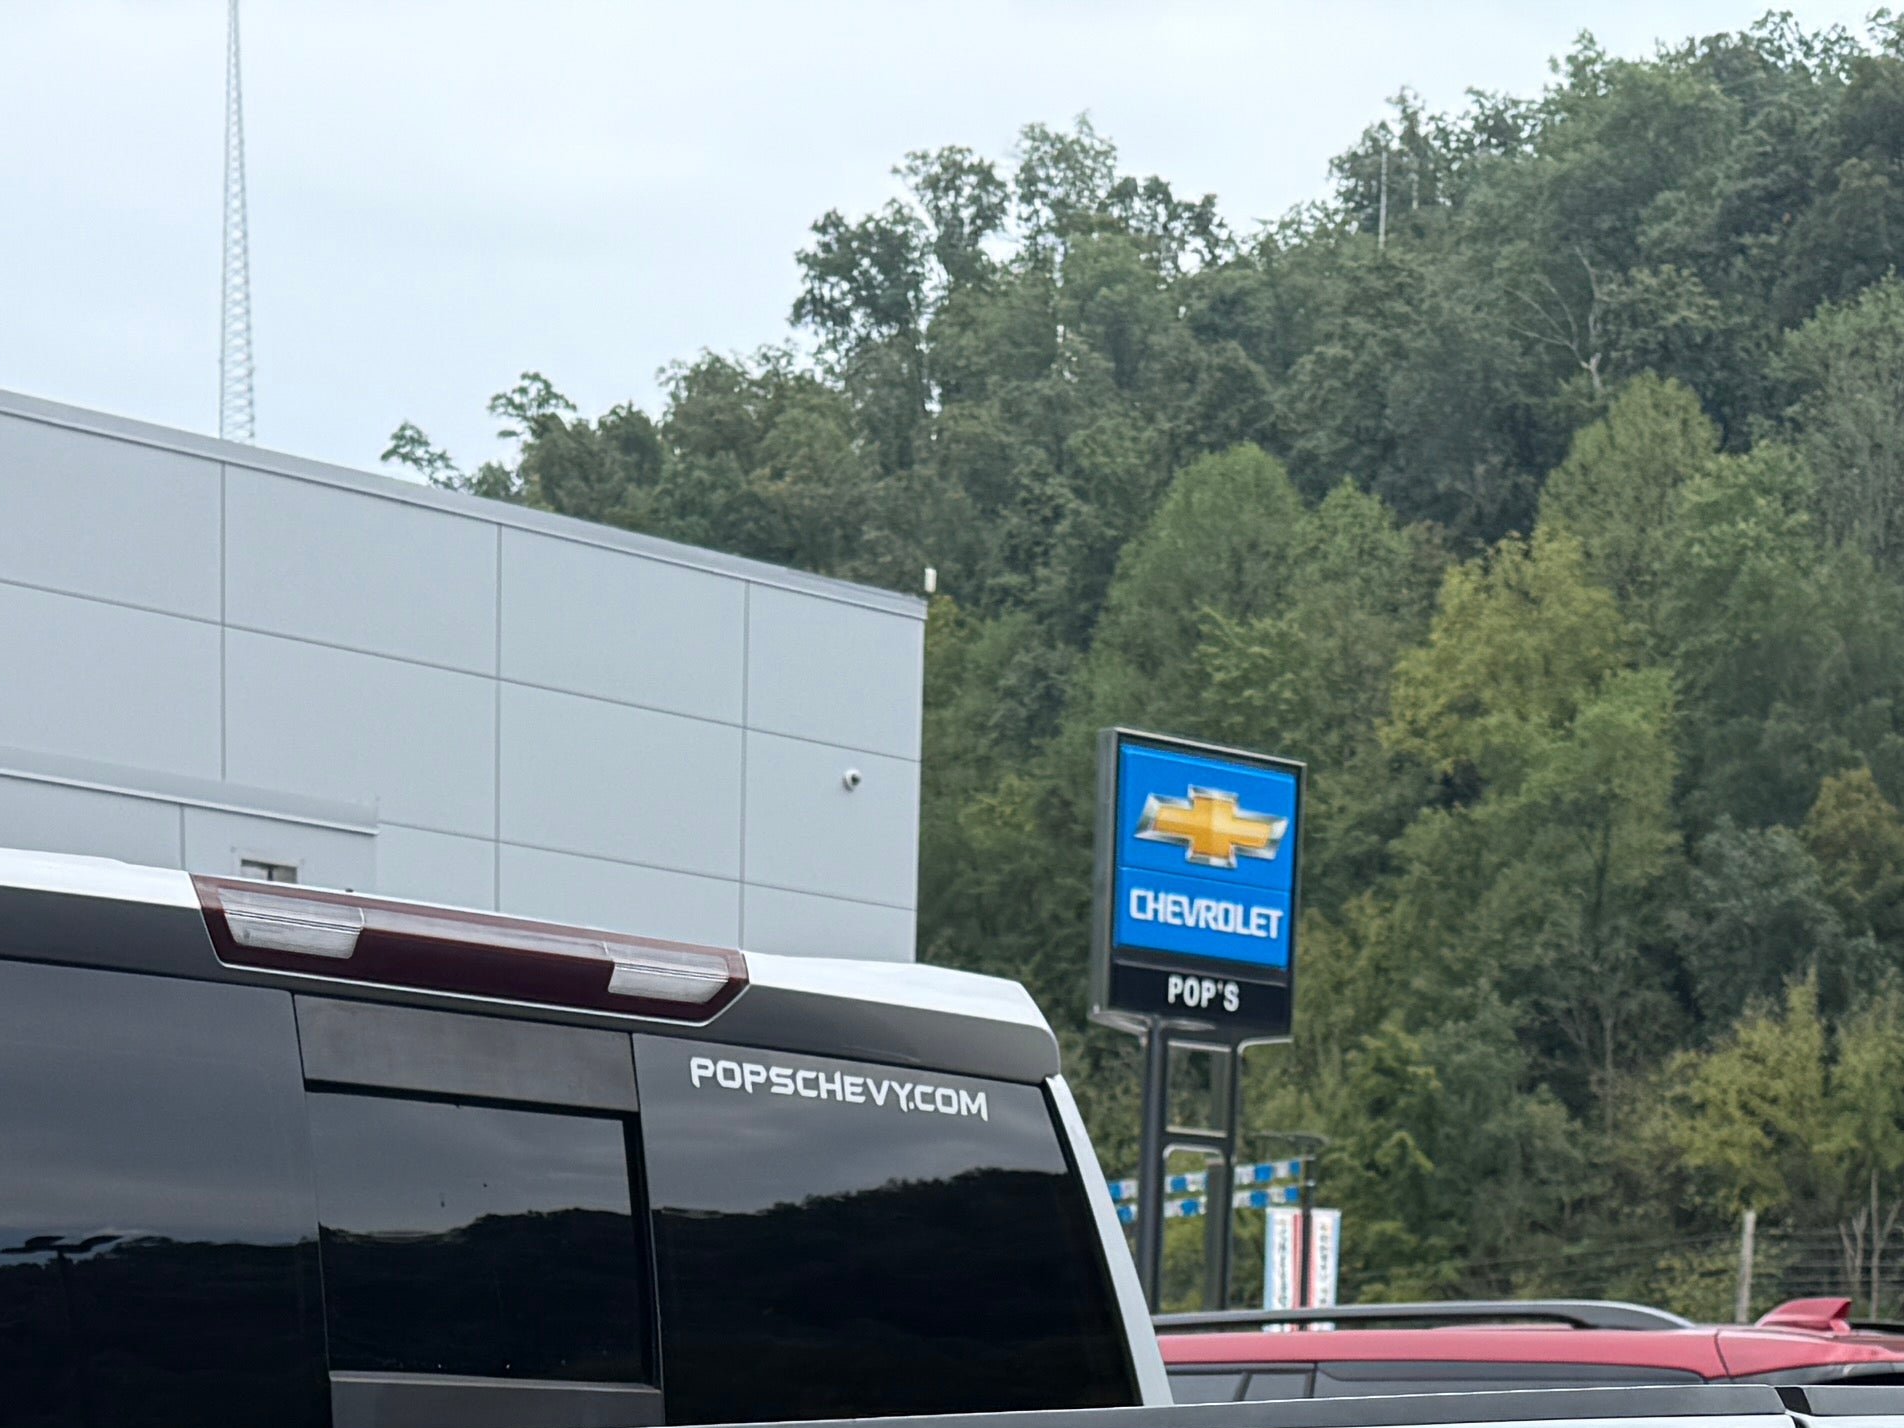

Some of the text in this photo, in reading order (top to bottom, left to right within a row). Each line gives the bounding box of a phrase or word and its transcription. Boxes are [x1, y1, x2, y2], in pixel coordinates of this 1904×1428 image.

[1129, 887, 1284, 940] CHEVROLET
[1168, 975, 1241, 1013] POP'S
[689, 1056, 988, 1122] POPSCHEVY.COM
